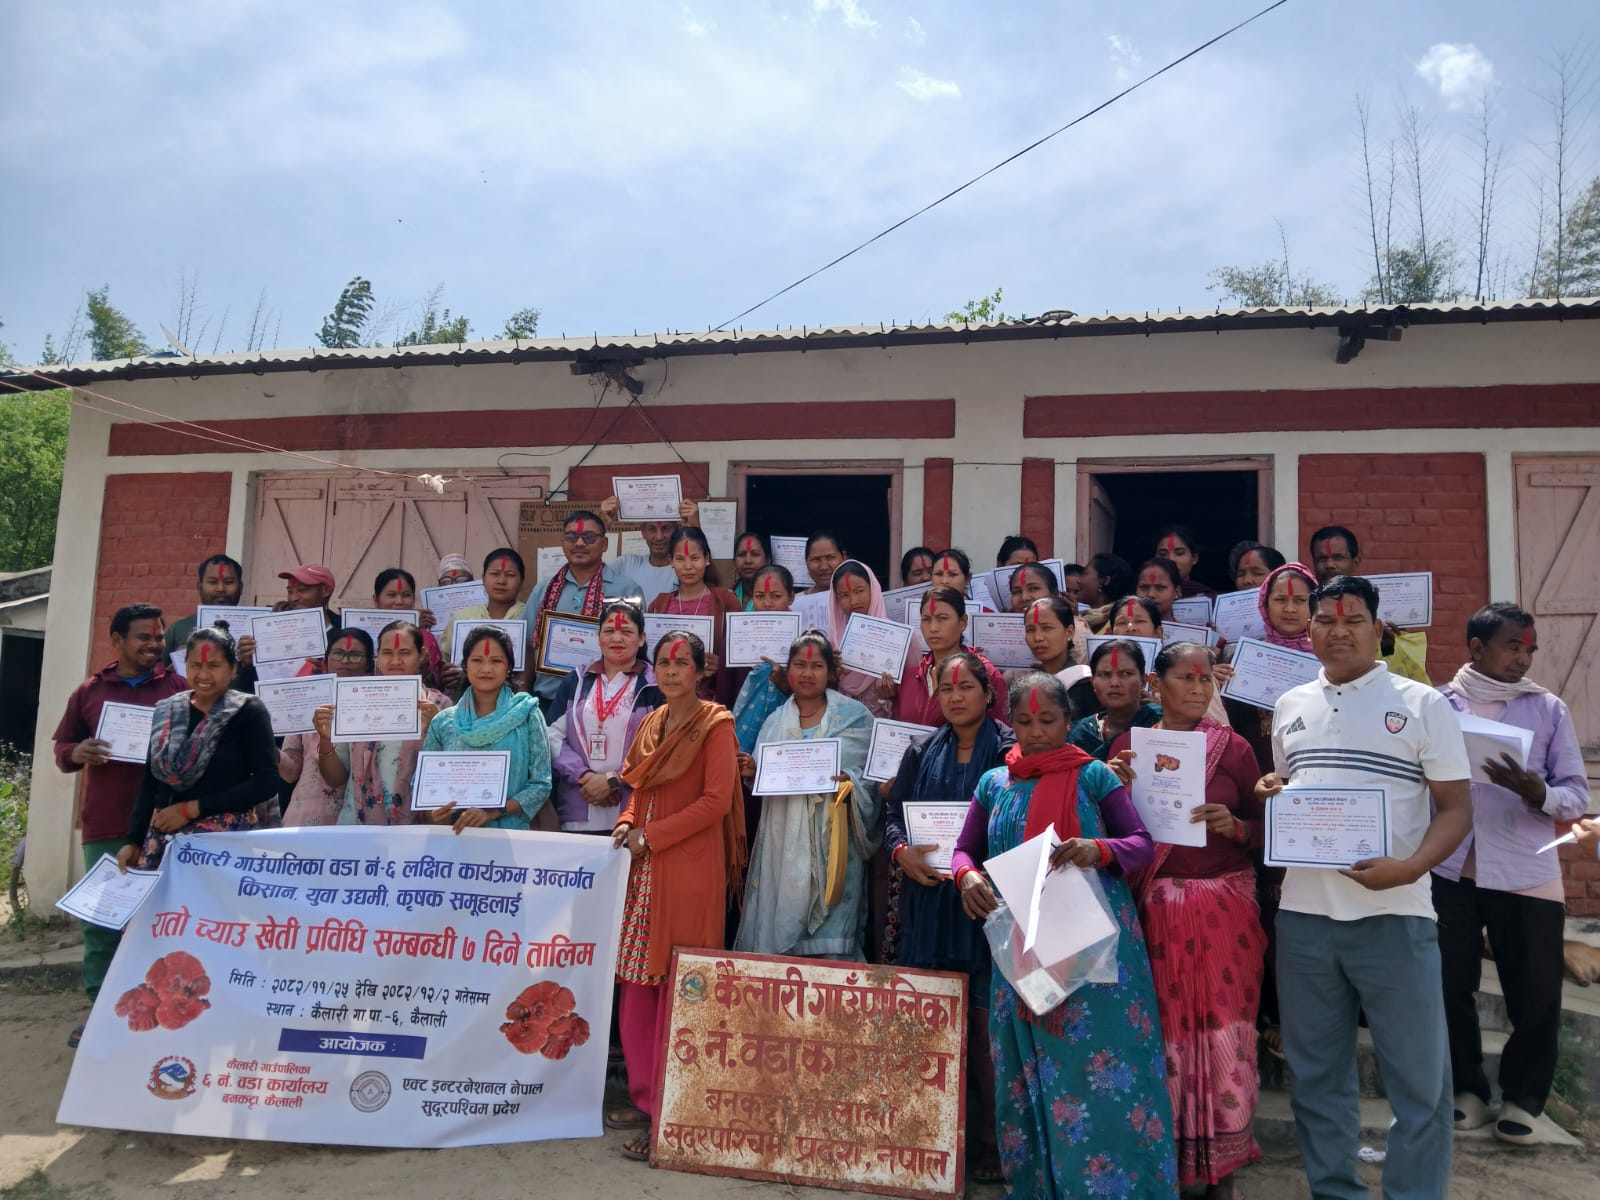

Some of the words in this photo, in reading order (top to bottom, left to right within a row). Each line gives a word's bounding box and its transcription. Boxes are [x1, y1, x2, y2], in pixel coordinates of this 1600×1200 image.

[177, 842, 231, 867] कैलारी
[234, 852, 324, 876] गाउँपालिका
[329, 858, 360, 877] वडा
[402, 855, 454, 879] लक्षित
[458, 860, 529, 884] कार्यक्रम
[532, 866, 596, 889] अन्तर्गत
[306, 888, 339, 907] युवा
[342, 884, 389, 907] उद्यमी,
[396, 889, 445, 911] कृषक
[450, 891, 522, 917] समूहलाई
[152, 905, 192, 938] रातो
[195, 918, 250, 947] च्याउ
[255, 915, 301, 950] खेती
[305, 917, 367, 954] प्रविधि
[373, 926, 458, 959] सम्बन्धी
[462, 935, 476, 961] ७
[482, 929, 522, 966] दिने
[526, 934, 596, 968] तालिम
[229, 968, 257, 988] मिति
[272, 978, 349, 998] २०८२/११/२५
[354, 978, 379, 998] देखि
[382, 984, 450, 1002] २०८२/१२/२
[455, 986, 491, 1006] गतेसम्म
[714, 960, 808, 1022] कैलारी
[267, 1002, 295, 1016] स्थान
[311, 1001, 349, 1023] कैलारी
[410, 1006, 447, 1028] कैलाली
[319, 1036, 386, 1052] आयोजक
[674, 1028, 701, 1071] ६
[740, 1033, 801, 1074] वडा
[227, 1058, 258, 1071] कैलारी
[202, 1073, 212, 1088] ६
[217, 1072, 232, 1088] नं.
[237, 1075, 263, 1090] वडा
[266, 1077, 328, 1094] कार्यालय
[402, 1078, 429, 1092] एक्ट
[431, 1078, 507, 1095] इन्टरनेशनल
[510, 1079, 544, 1096] नेपाल
[264, 1093, 304, 1108] कैलाली
[421, 1098, 489, 1117] सुदूरपश्चिम
[492, 1100, 520, 1116] प्रदेश
[876, 1134, 951, 1183] नेपाल
